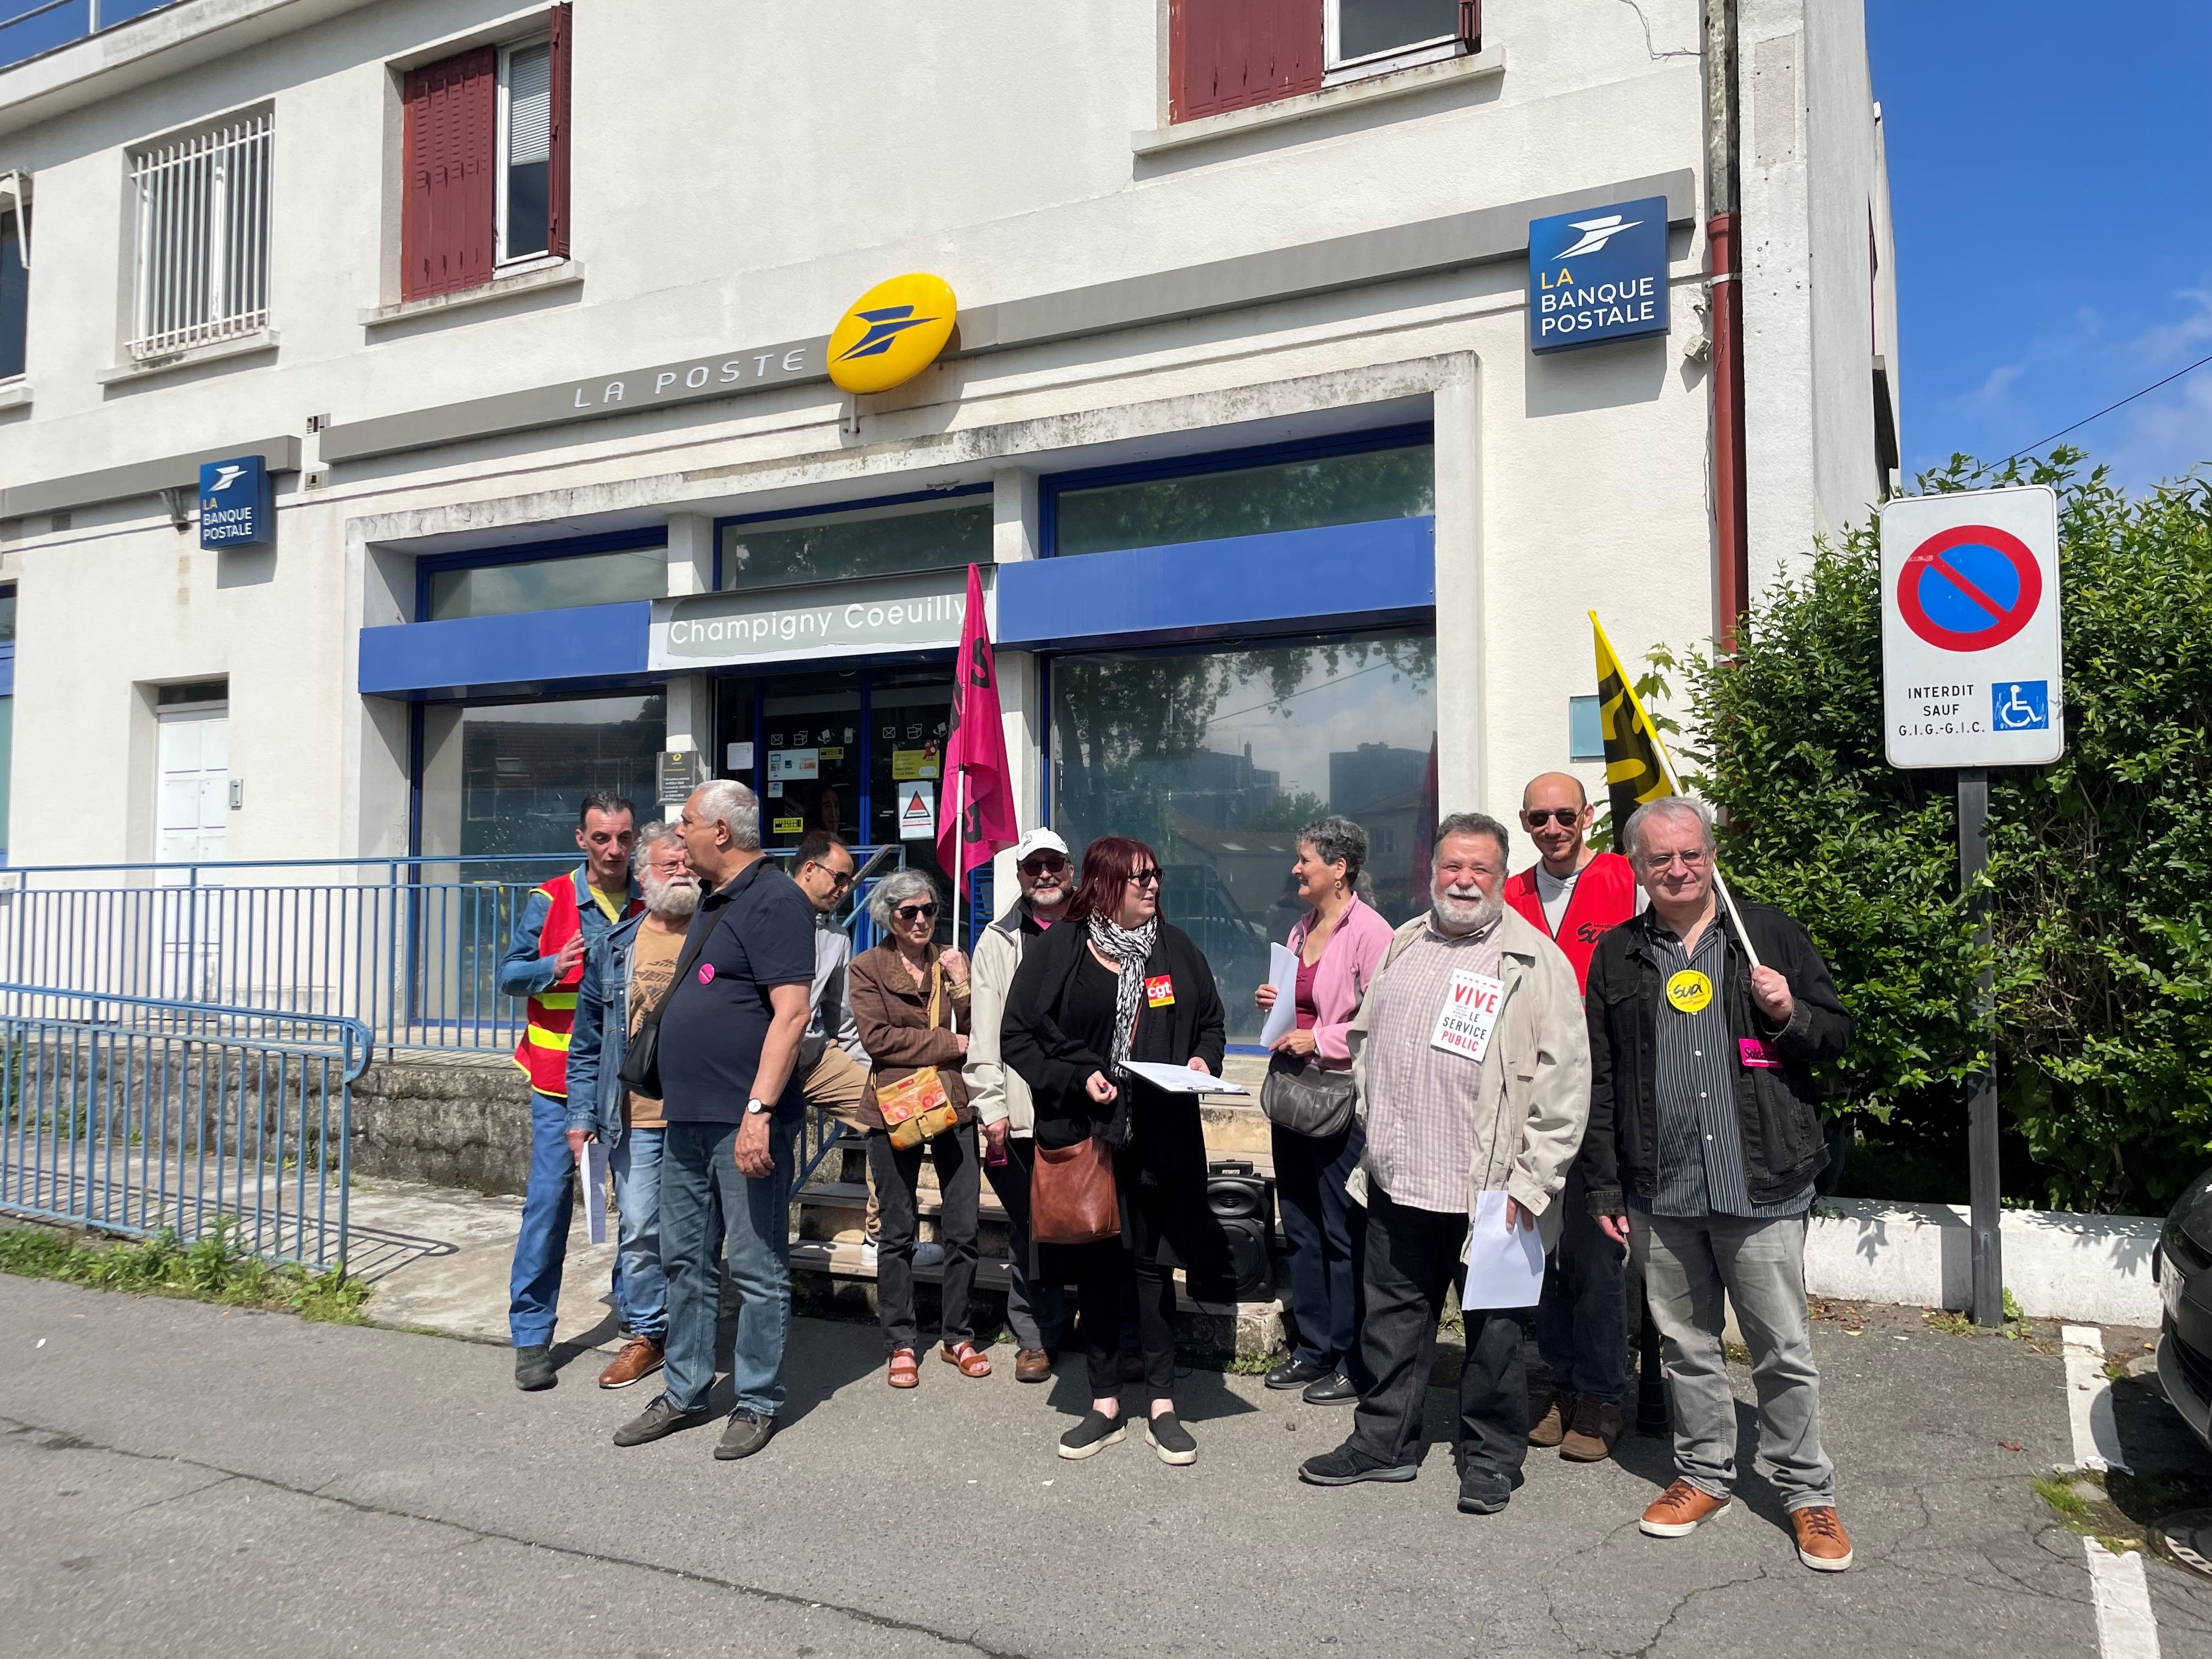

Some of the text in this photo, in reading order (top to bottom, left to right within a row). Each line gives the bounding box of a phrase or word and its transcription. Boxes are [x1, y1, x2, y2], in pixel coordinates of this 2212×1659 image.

[1541, 268, 1574, 290] LA
[1541, 276, 1655, 313] BANQUE
[1541, 300, 1655, 336] POSTALE
[574, 348, 806, 408] LA POSTE
[202, 497, 218, 511] LA
[202, 507, 253, 526] BANQUE
[202, 522, 253, 541] POSTALE
[669, 594, 967, 645] Champigny Coeuilly
[1908, 684, 1974, 699] INTERDIT
[1923, 704, 1960, 717] SAUF
[1898, 721, 1985, 736] G.I.G.-G.I.C.
[1147, 981, 1173, 999] cgt
[1454, 984, 1498, 1014] VIVE
[1469, 1012, 1480, 1023] LE
[1442, 1017, 1487, 1040] SERVICE
[1441, 1030, 1479, 1052] PUBLIC
